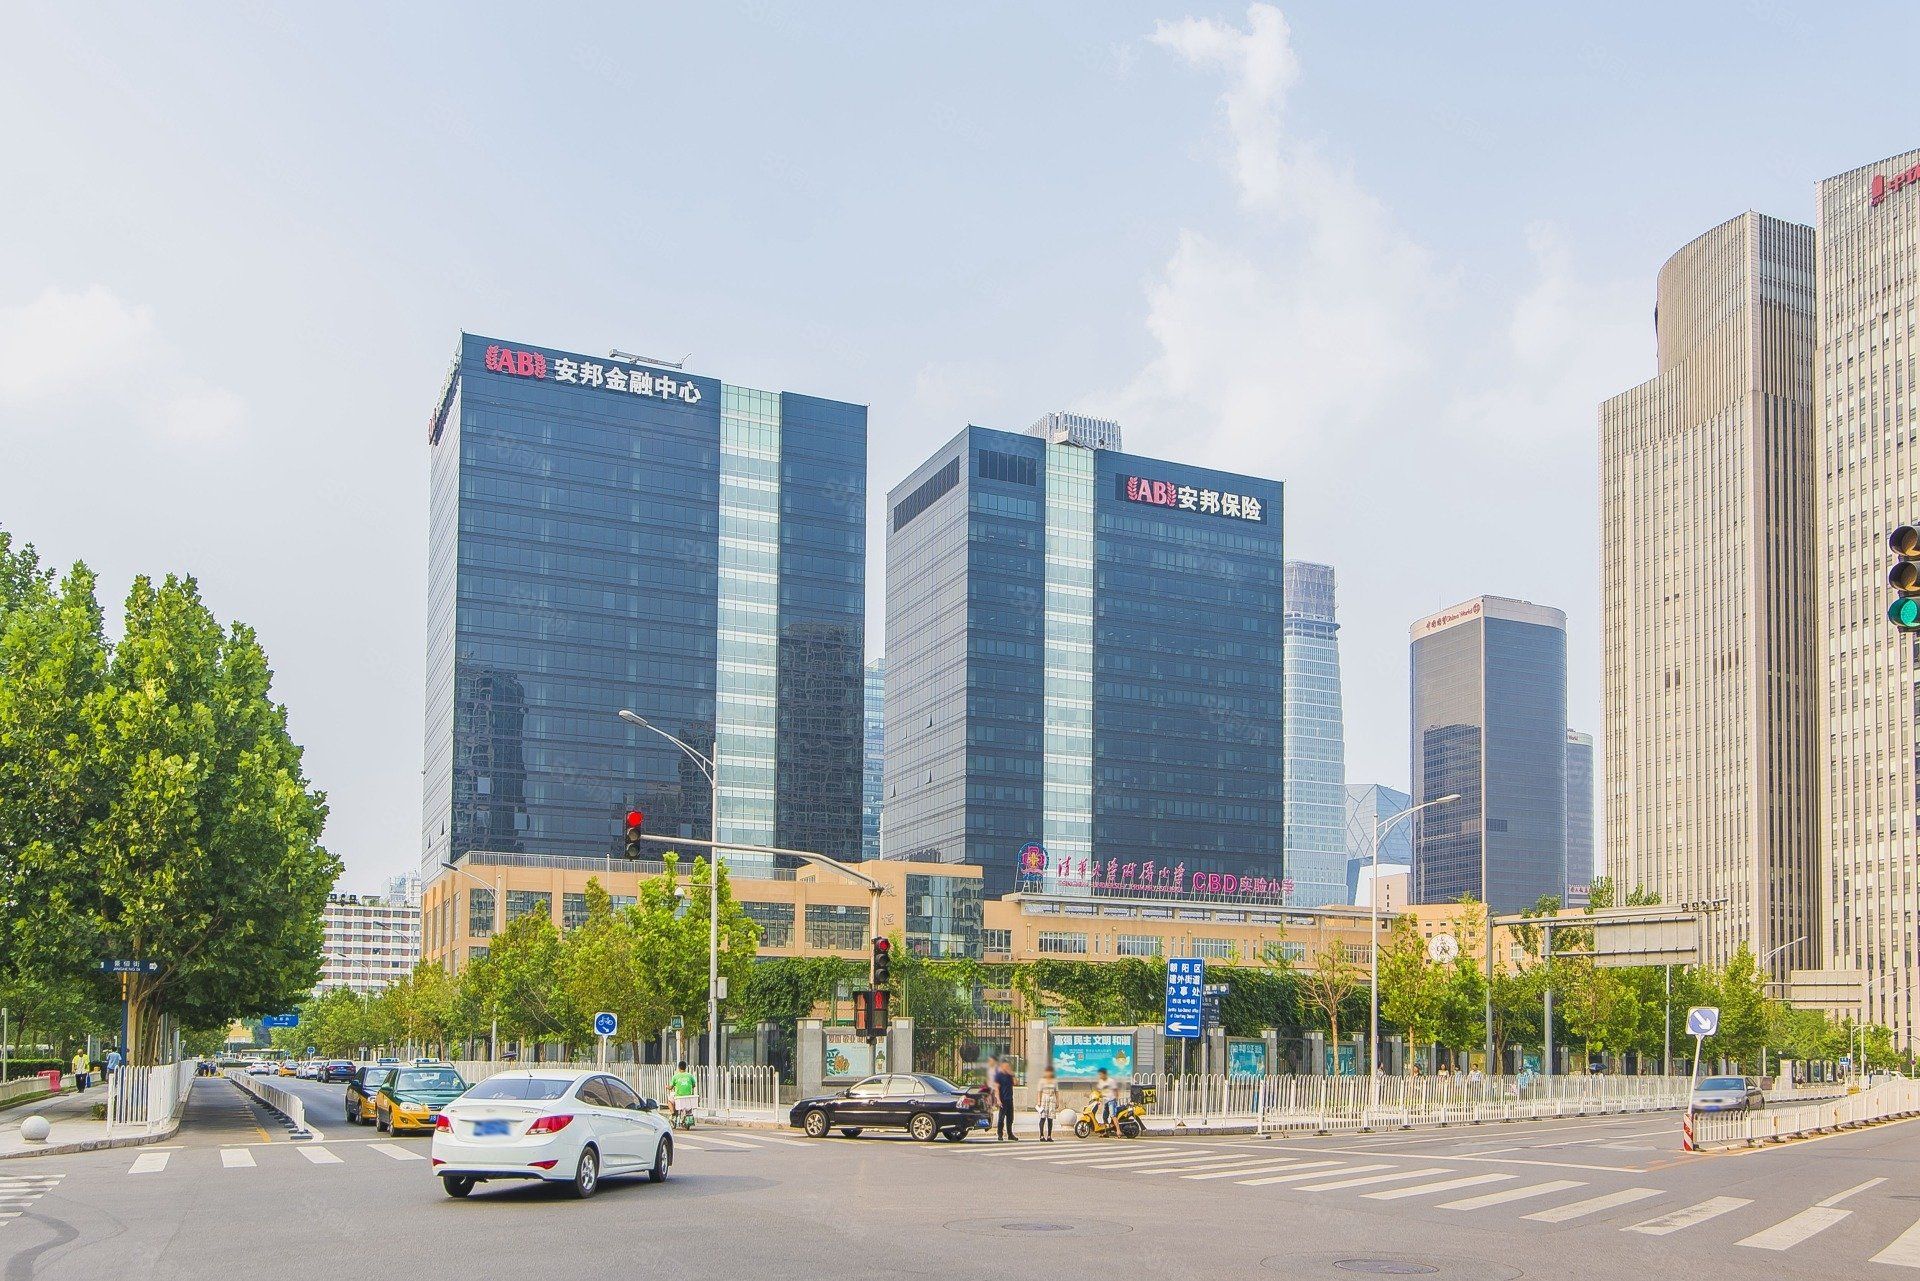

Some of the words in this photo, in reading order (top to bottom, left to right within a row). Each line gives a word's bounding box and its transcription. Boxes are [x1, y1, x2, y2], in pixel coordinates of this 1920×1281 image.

[554, 358, 702, 404] 安邦金融中心
[1177, 486, 1262, 521] 安邦保险
[1169, 963, 1201, 973] 朝阳区
[1169, 974, 1201, 985] 建外街道
[1168, 986, 1201, 997] 办事处
[1073, 1035, 1092, 1046] 民主
[1093, 1035, 1111, 1046] 文明
[1112, 1035, 1131, 1046] 和谐
